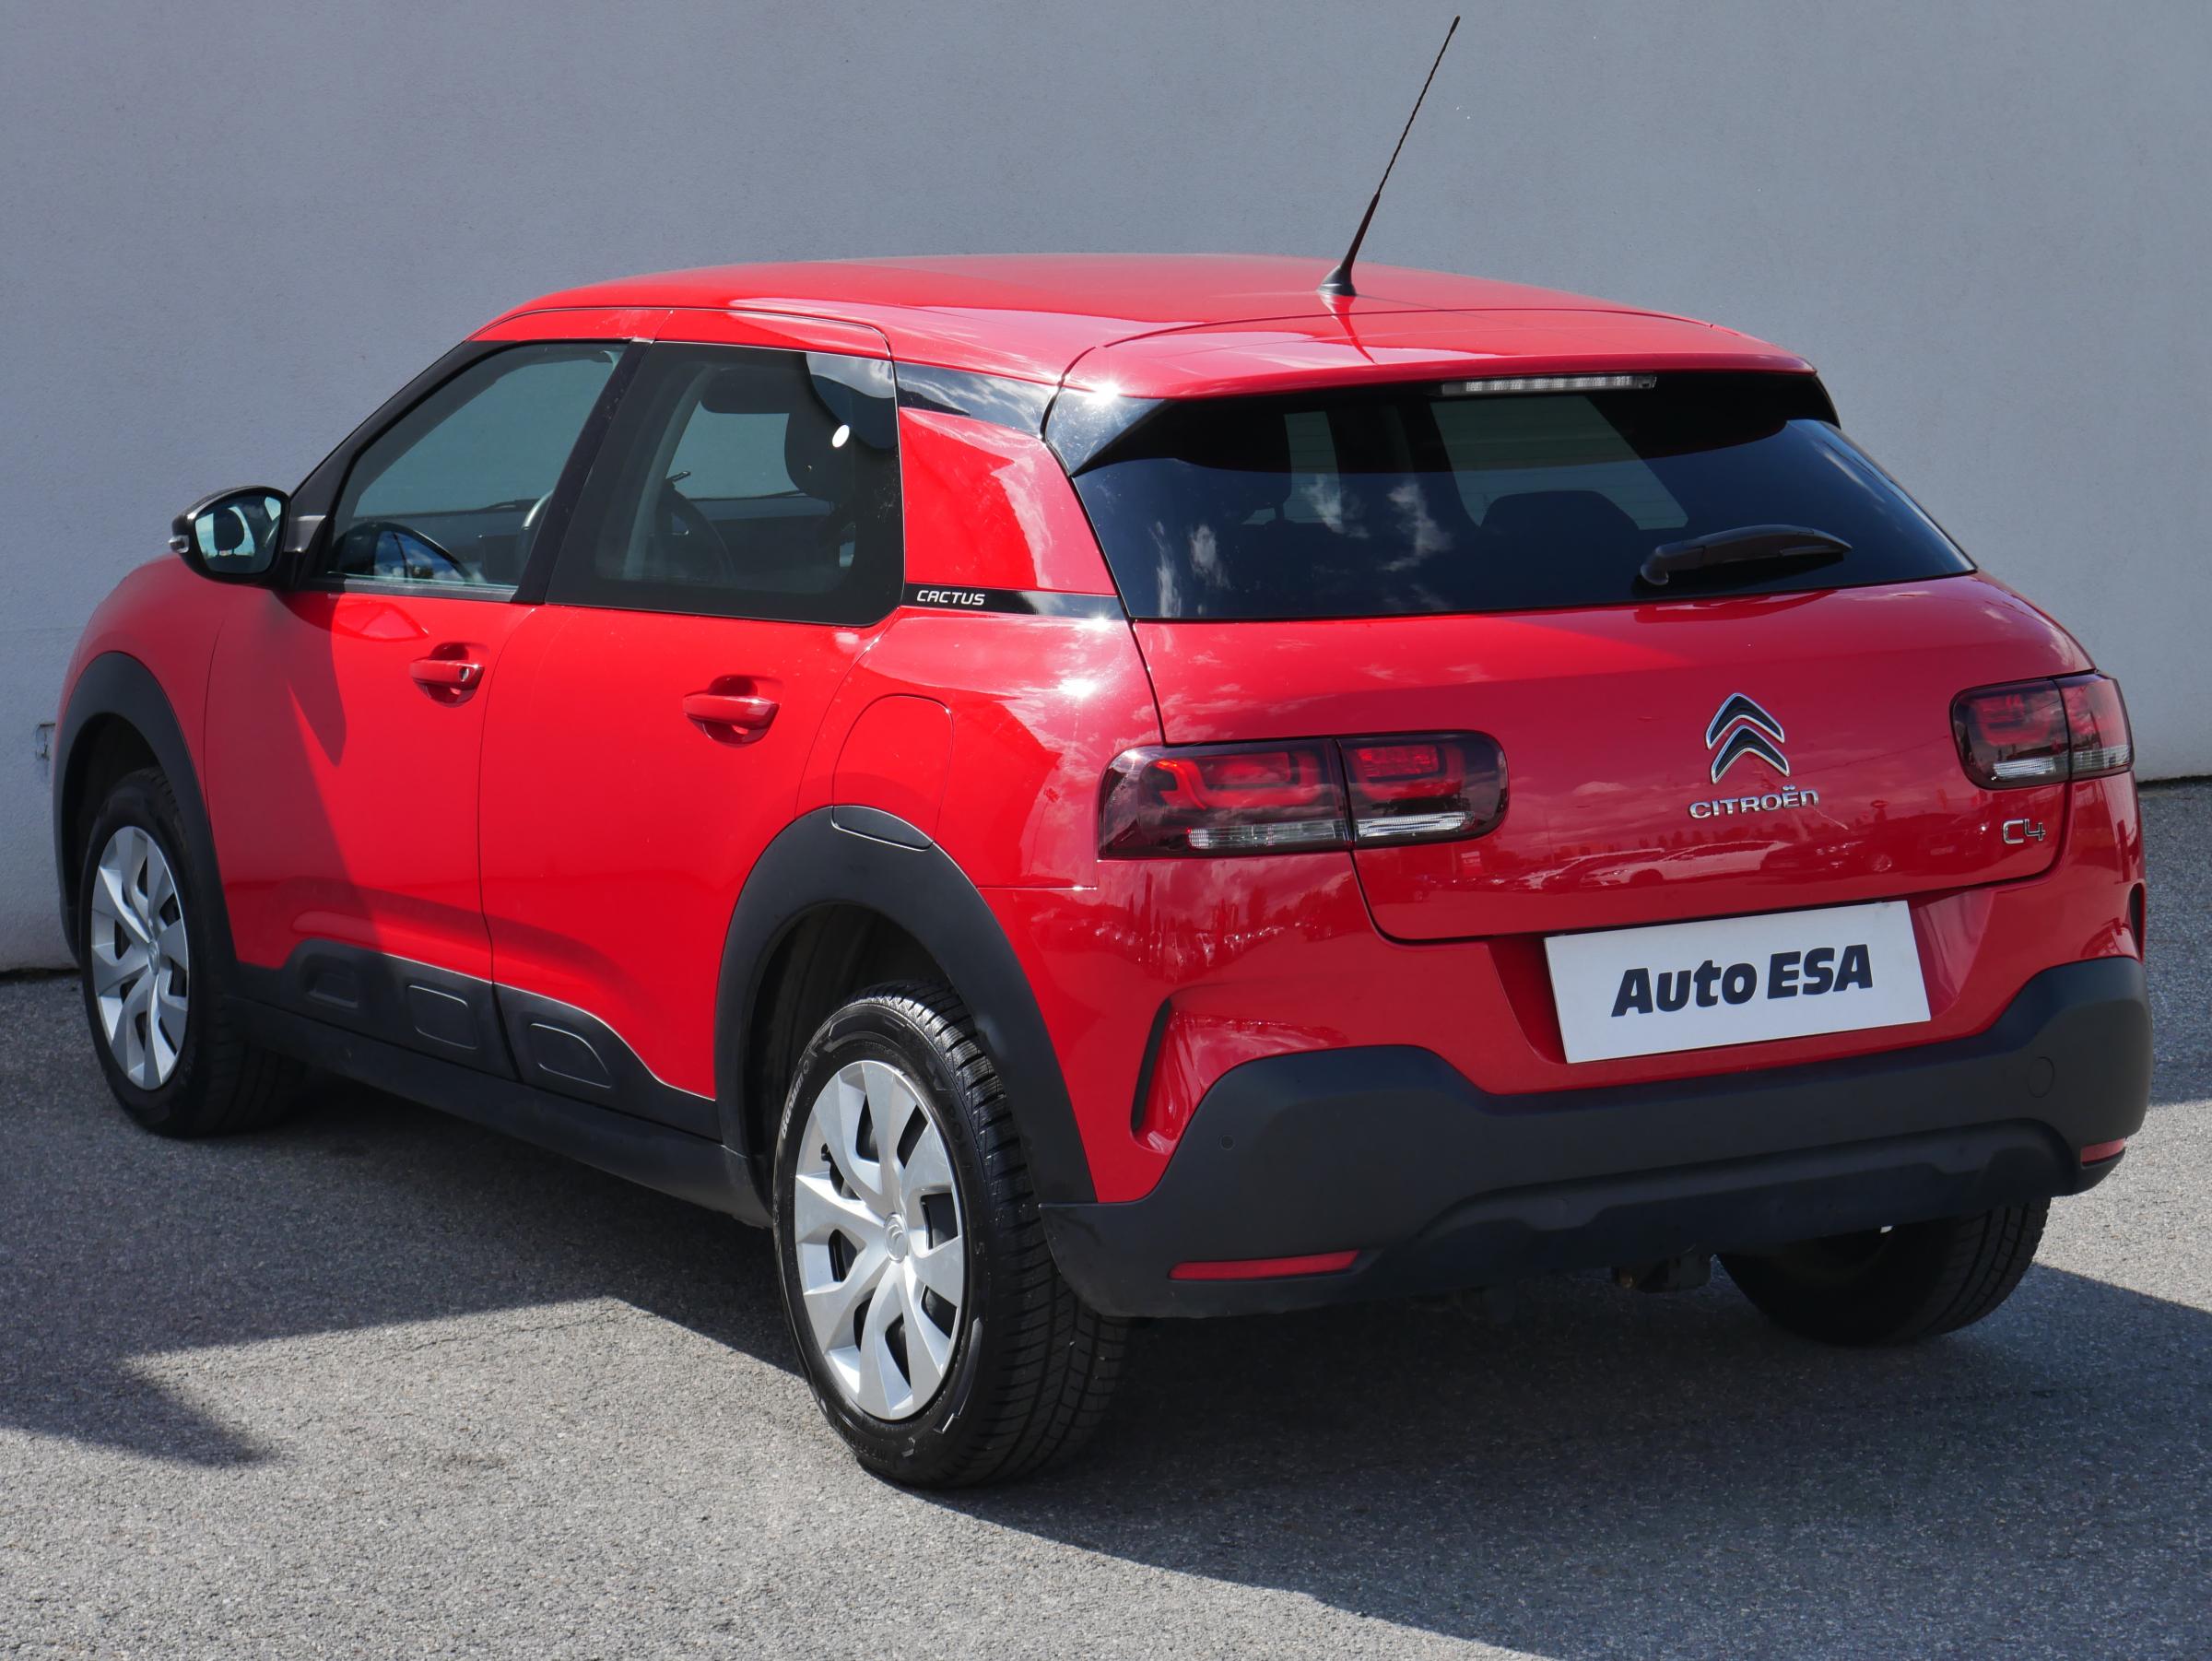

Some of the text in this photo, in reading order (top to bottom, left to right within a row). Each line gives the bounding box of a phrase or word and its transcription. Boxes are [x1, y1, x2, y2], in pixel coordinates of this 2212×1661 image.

[916, 590, 985, 606] CACTUS
[2003, 819, 2046, 844] C4
[1610, 943, 1873, 1017] Auto ESA
